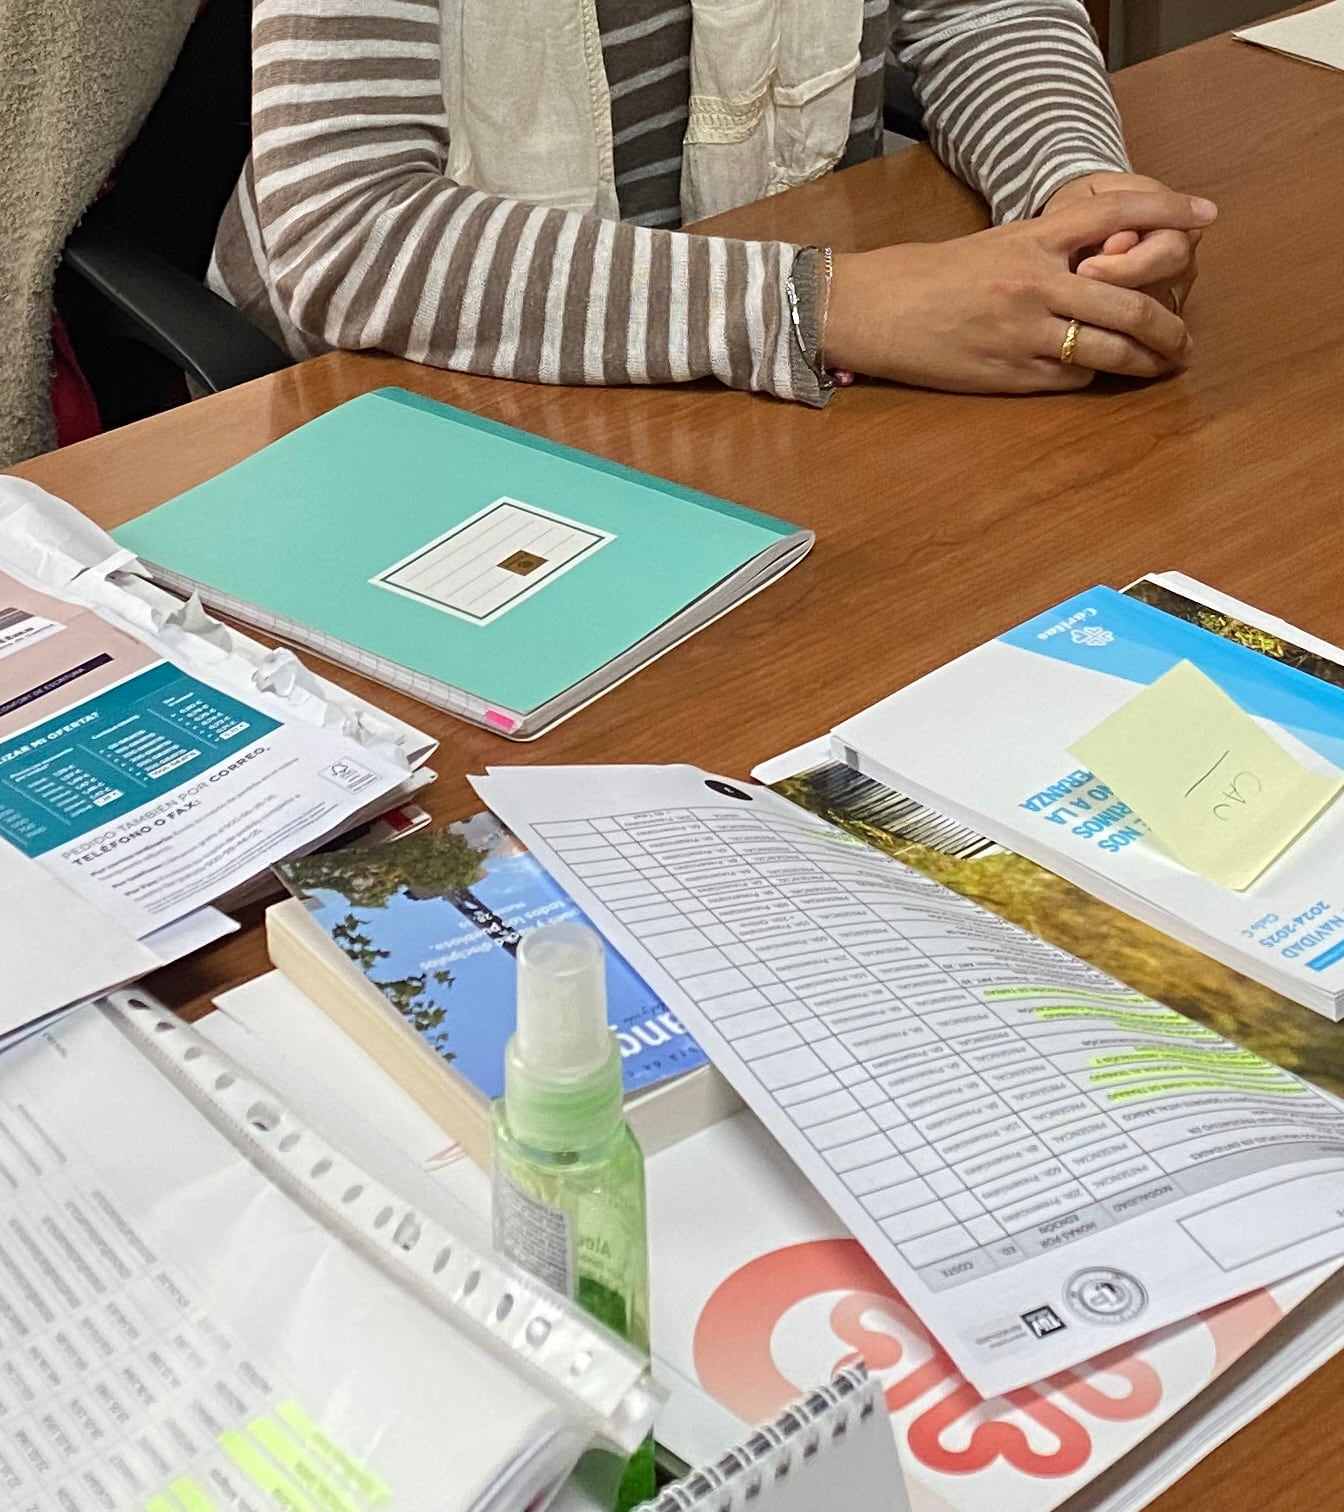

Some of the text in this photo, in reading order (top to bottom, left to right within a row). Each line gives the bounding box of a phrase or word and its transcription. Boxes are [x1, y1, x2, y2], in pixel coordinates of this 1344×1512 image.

[1035, 607, 1098, 641] Cáritas
[61, 829, 116, 860] PEDIDO
[177, 779, 208, 802] POR
[1042, 796, 1088, 827] A LA
[72, 822, 153, 867] TELÉFONO
[153, 815, 167, 828] O
[1096, 824, 1144, 854] NOS
[1240, 911, 1279, 940] Ciclo C
[1257, 899, 1330, 950] 2024-2025
[1279, 914, 1344, 961] NAVIDAD
[1051, 1121, 1107, 1145] PRESENCIAL
[1070, 1141, 1128, 1167] PRESENCIAL
[980, 1173, 1040, 1201] Presenciales
[1091, 1163, 1148, 1190] PRESENCIAL
[1001, 1196, 1060, 1225] Presenciales
[1112, 1183, 1172, 1213] MODALIDAD
[1039, 1234, 1060, 1249] POR
[1060, 1220, 1096, 1241] HORAS
[941, 1260, 973, 1277] COSTE
